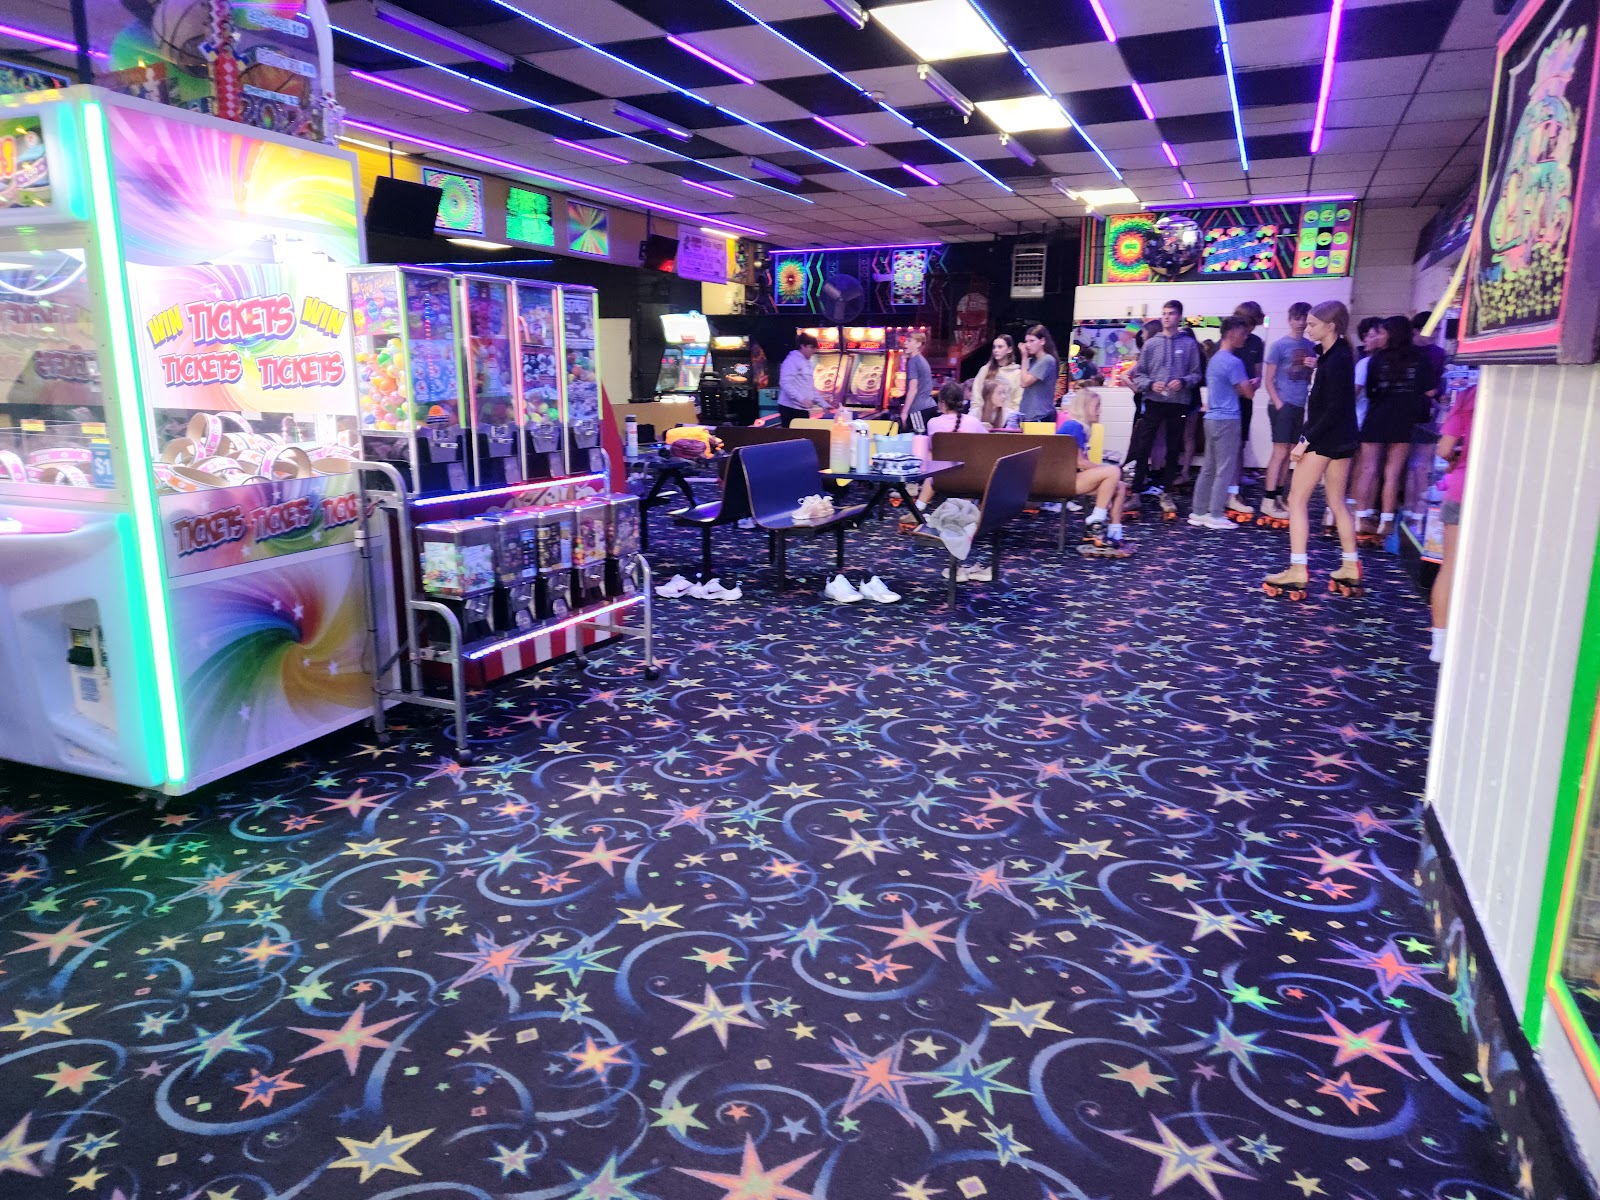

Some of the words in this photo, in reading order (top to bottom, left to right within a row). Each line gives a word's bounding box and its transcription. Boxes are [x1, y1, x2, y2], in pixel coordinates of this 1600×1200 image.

[147, 303, 185, 350] WIN
[184, 293, 298, 347] TICKETS
[300, 296, 348, 338] WIN
[159, 350, 244, 388] TICKETS
[255, 351, 346, 390] TICKETS
[94, 457, 113, 476] $1
